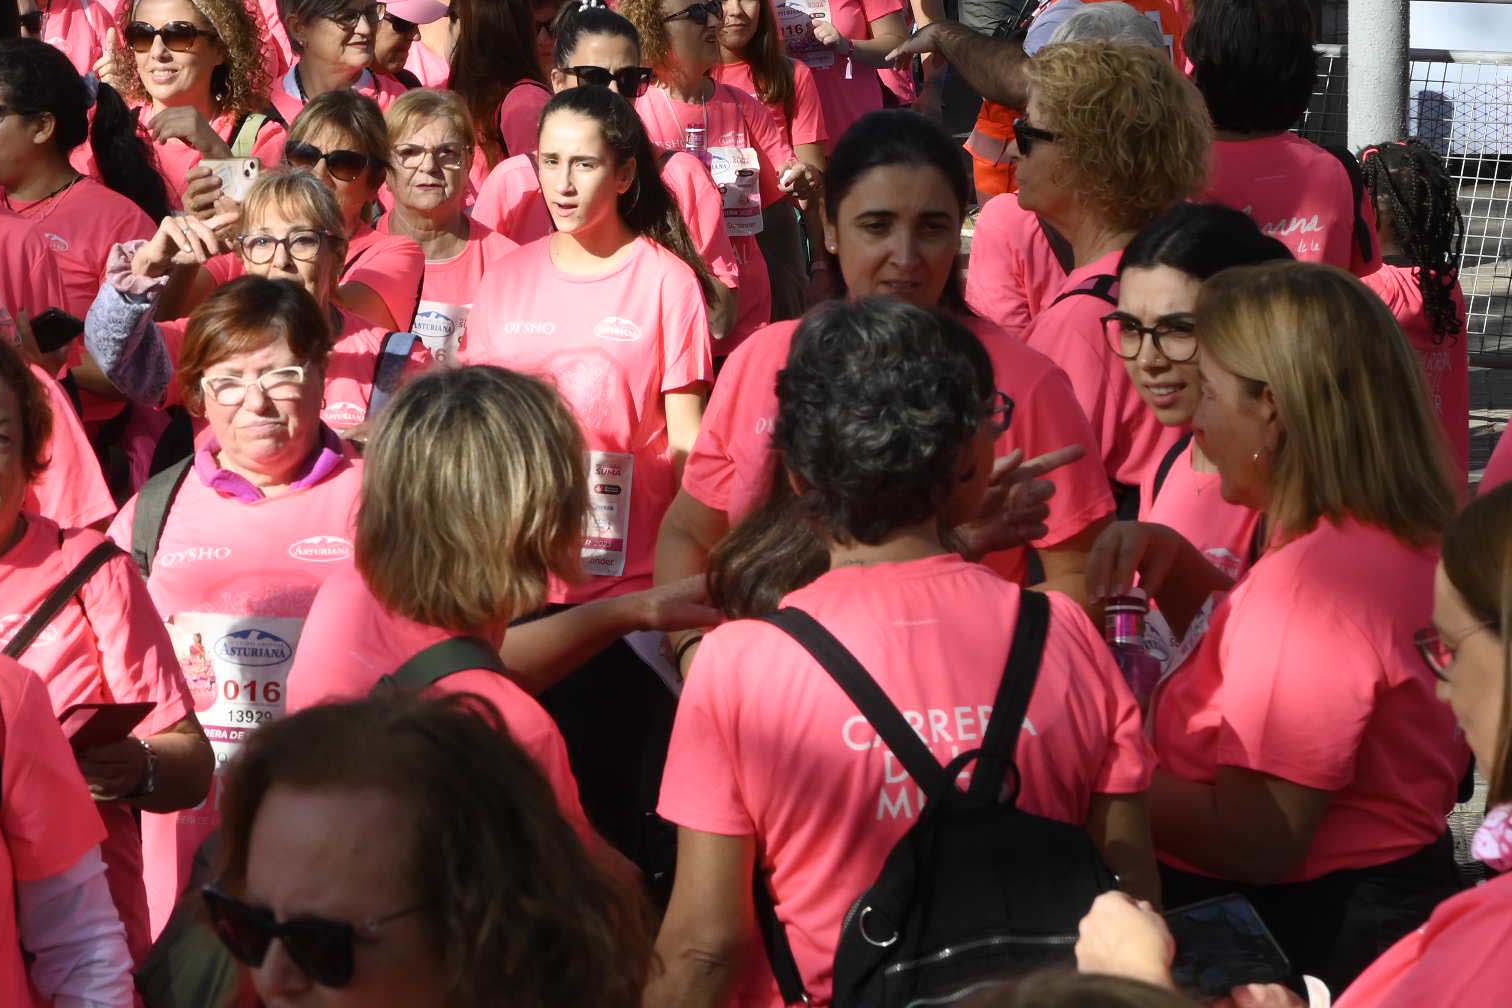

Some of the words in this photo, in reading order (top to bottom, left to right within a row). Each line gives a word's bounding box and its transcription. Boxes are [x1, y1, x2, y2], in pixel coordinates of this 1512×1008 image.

[292, 541, 351, 557] ASTURIANA
[219, 640, 287, 659] ASTURIANA
[222, 679, 282, 704] 016
